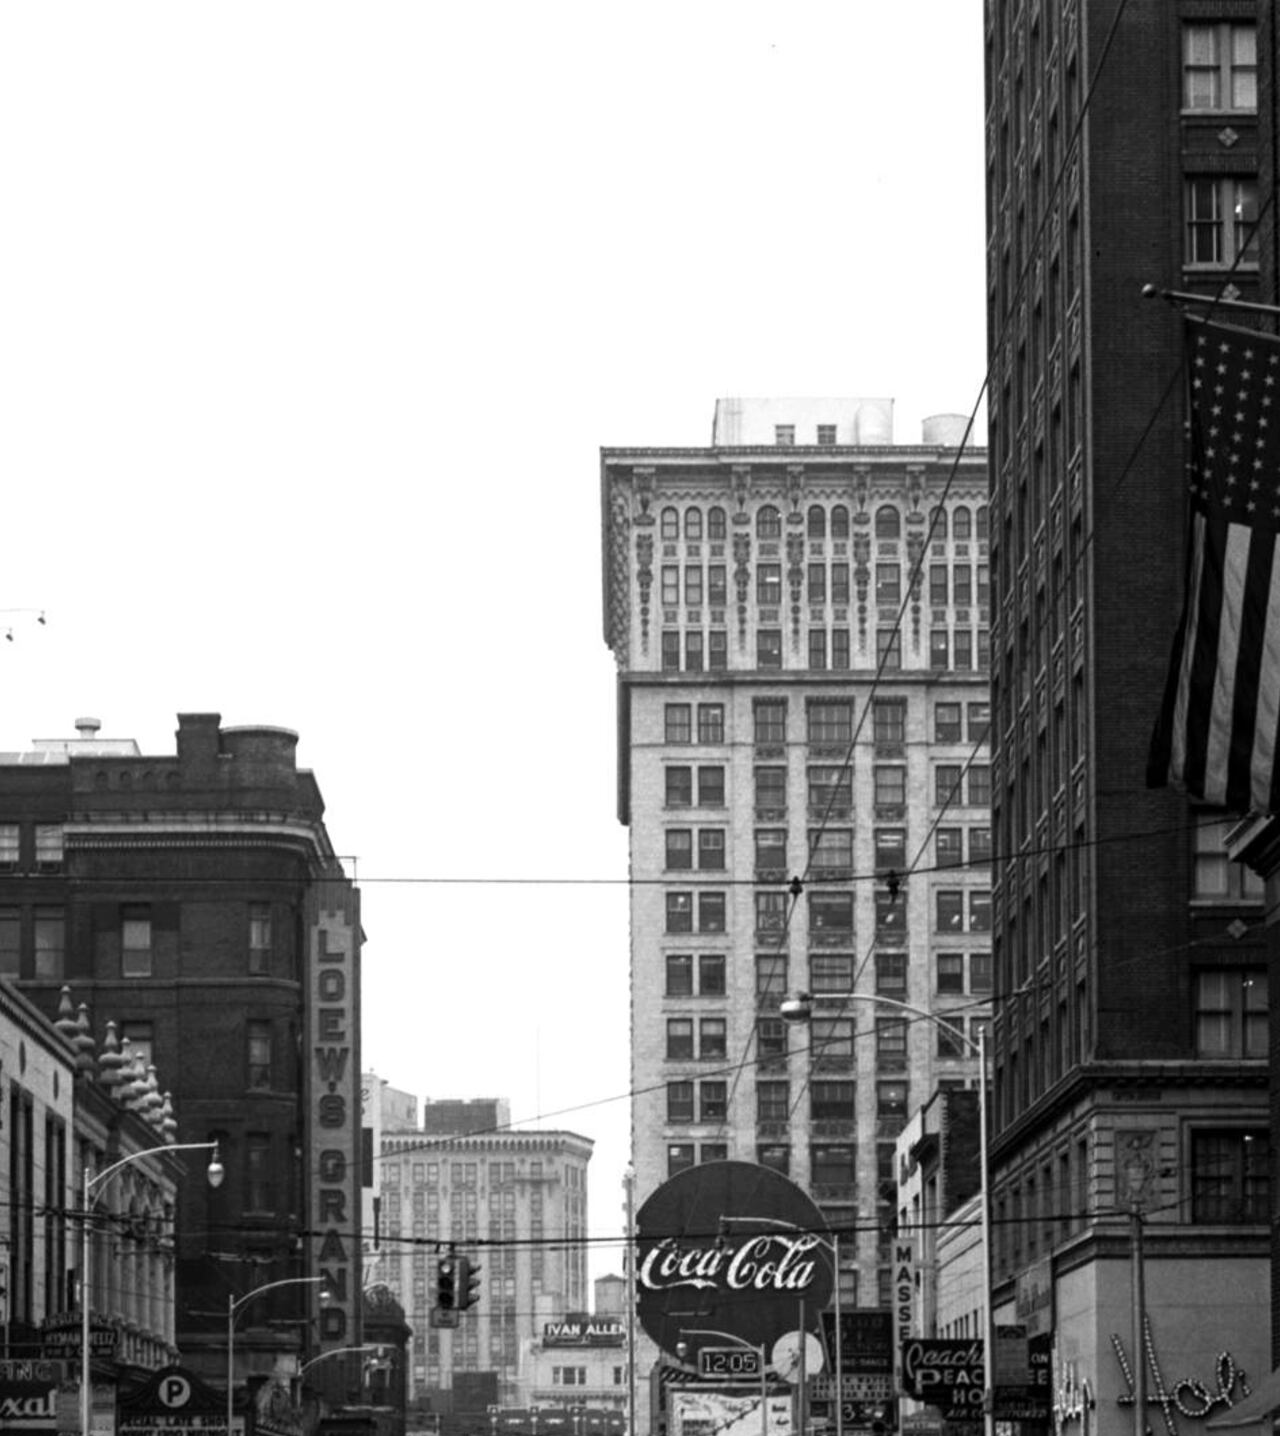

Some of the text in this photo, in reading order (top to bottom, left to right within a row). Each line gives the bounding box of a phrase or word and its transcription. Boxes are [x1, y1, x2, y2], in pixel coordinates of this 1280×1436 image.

[314, 929, 350, 1129] LOEW'S
[318, 1149, 348, 1341] GRAND
[896, 1245, 912, 1350] MASSE
[548, 1323, 581, 1336] IVAN
[166, 1379, 185, 1404] P
